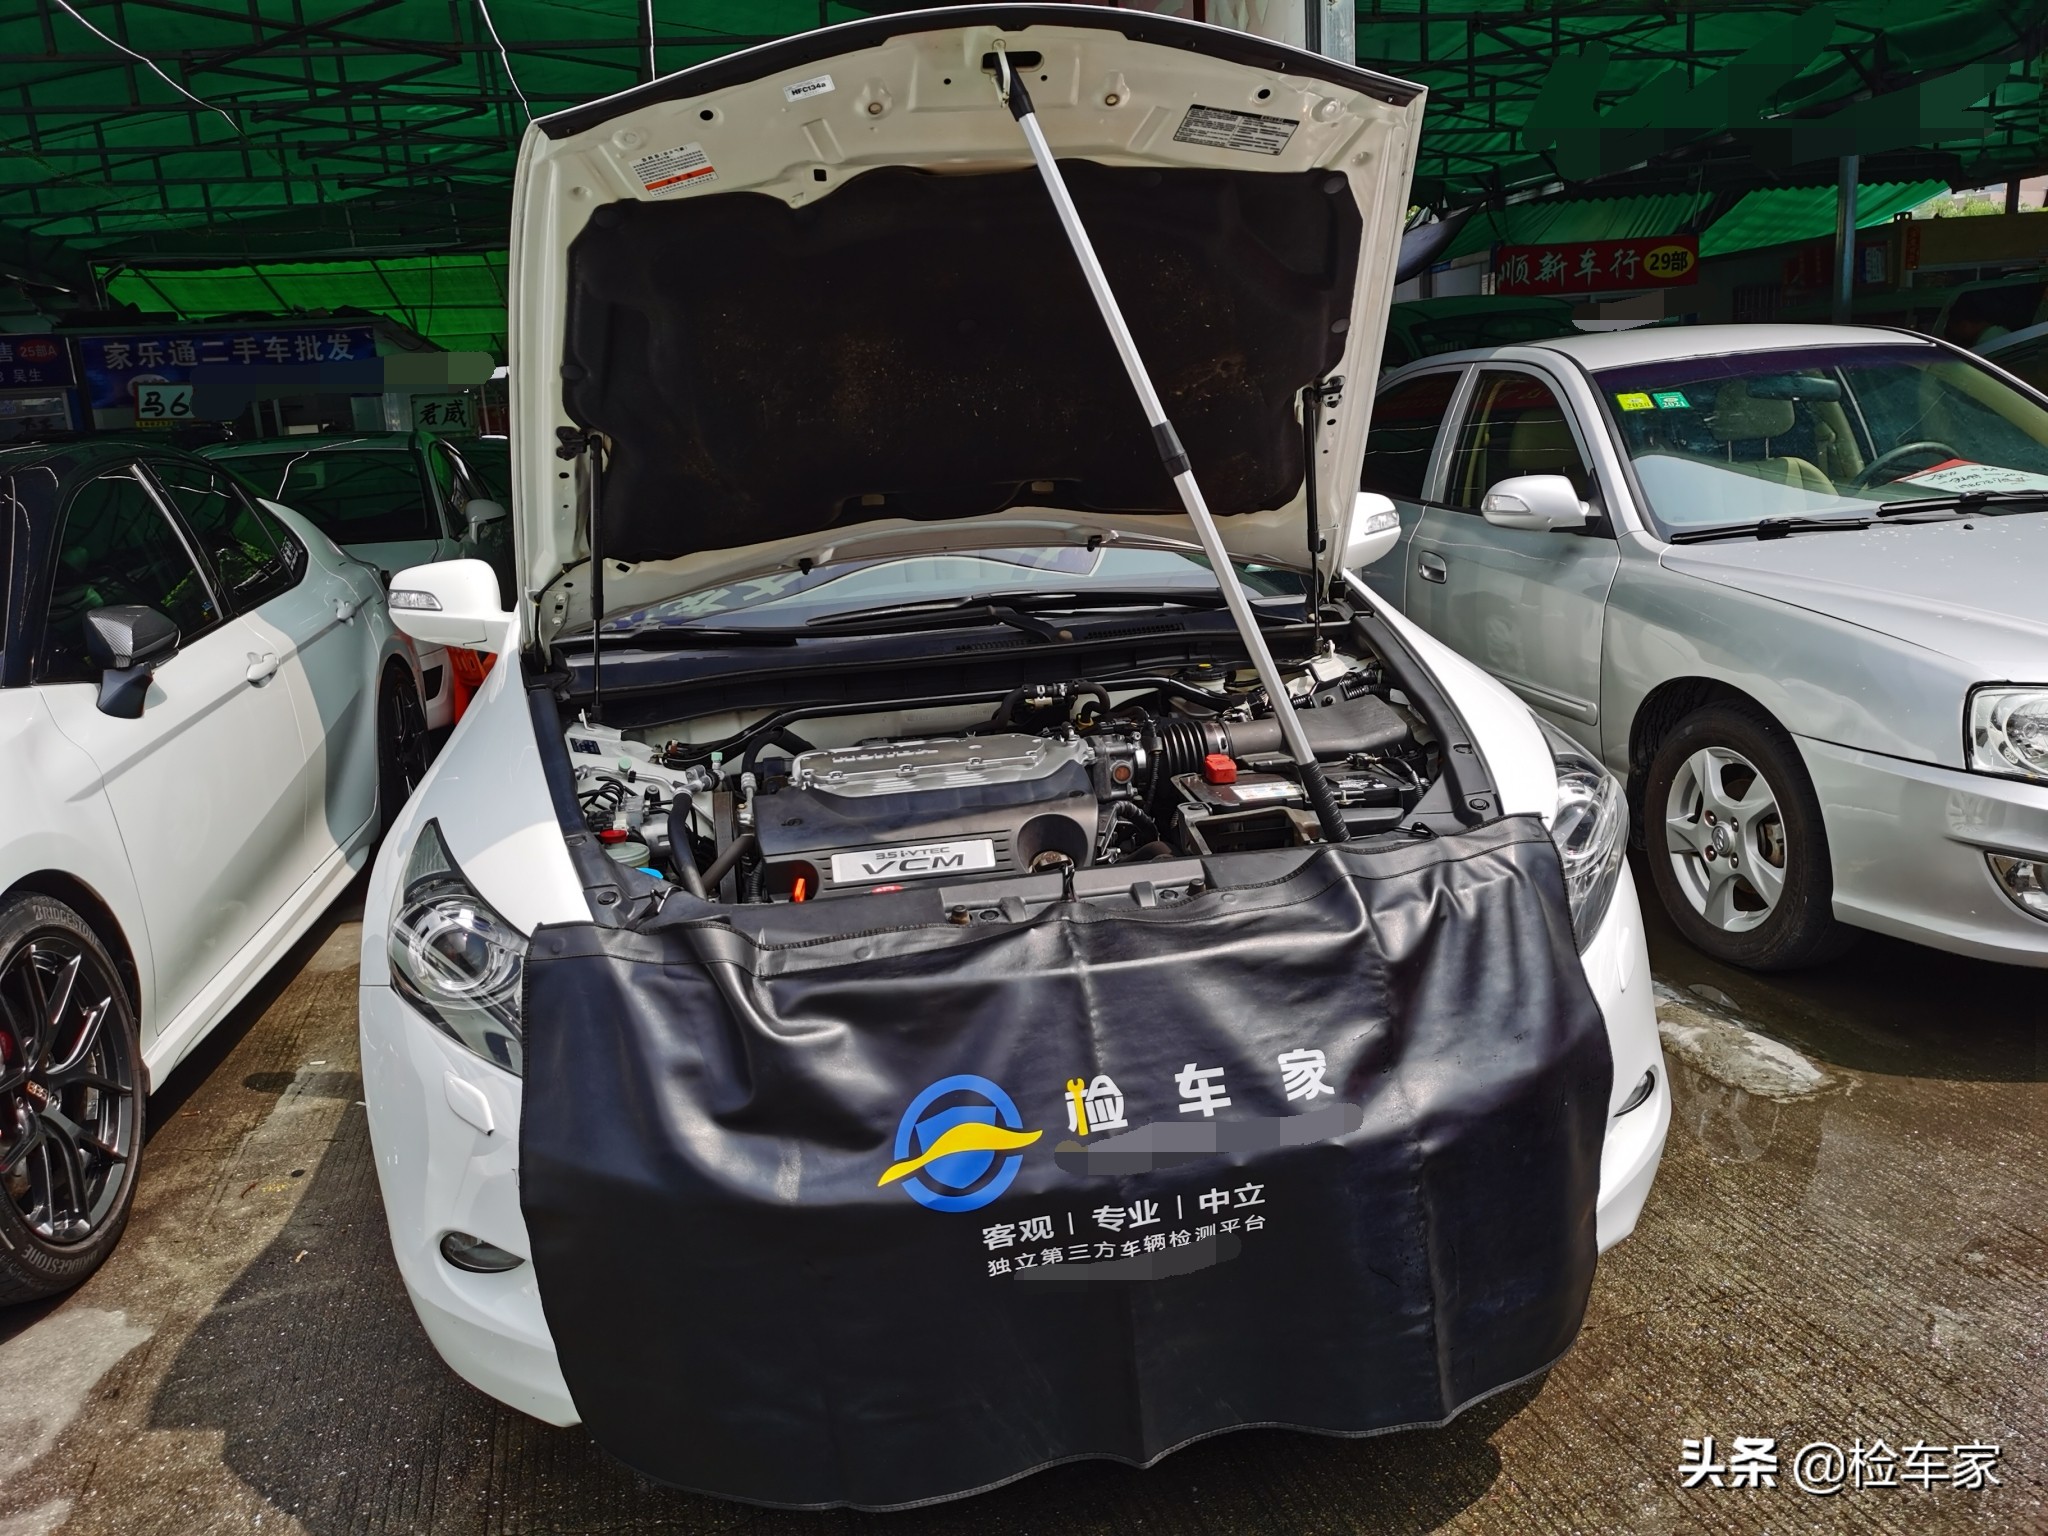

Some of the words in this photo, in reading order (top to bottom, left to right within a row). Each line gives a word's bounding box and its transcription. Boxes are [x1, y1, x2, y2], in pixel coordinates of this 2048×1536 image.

[1496, 248, 1641, 288] 顺新车行
[1649, 250, 1689, 272] 29部
[19, 344, 58, 358] 25部A
[103, 333, 356, 370] 家乐通二手车批发
[13, 368, 43, 383] 吴生
[142, 391, 190, 417] 马6
[419, 399, 467, 427] 君威
[862, 854, 964, 875] VCM
[32, 904, 101, 948] BRIDGESTONE
[1064, 1048, 1336, 1137] 检车家
[982, 1214, 1055, 1251] 客观
[1091, 1199, 1161, 1233] 专业
[1198, 1182, 1267, 1215] 中立
[986, 1213, 1267, 1278] 独立第三方车辆检测平台
